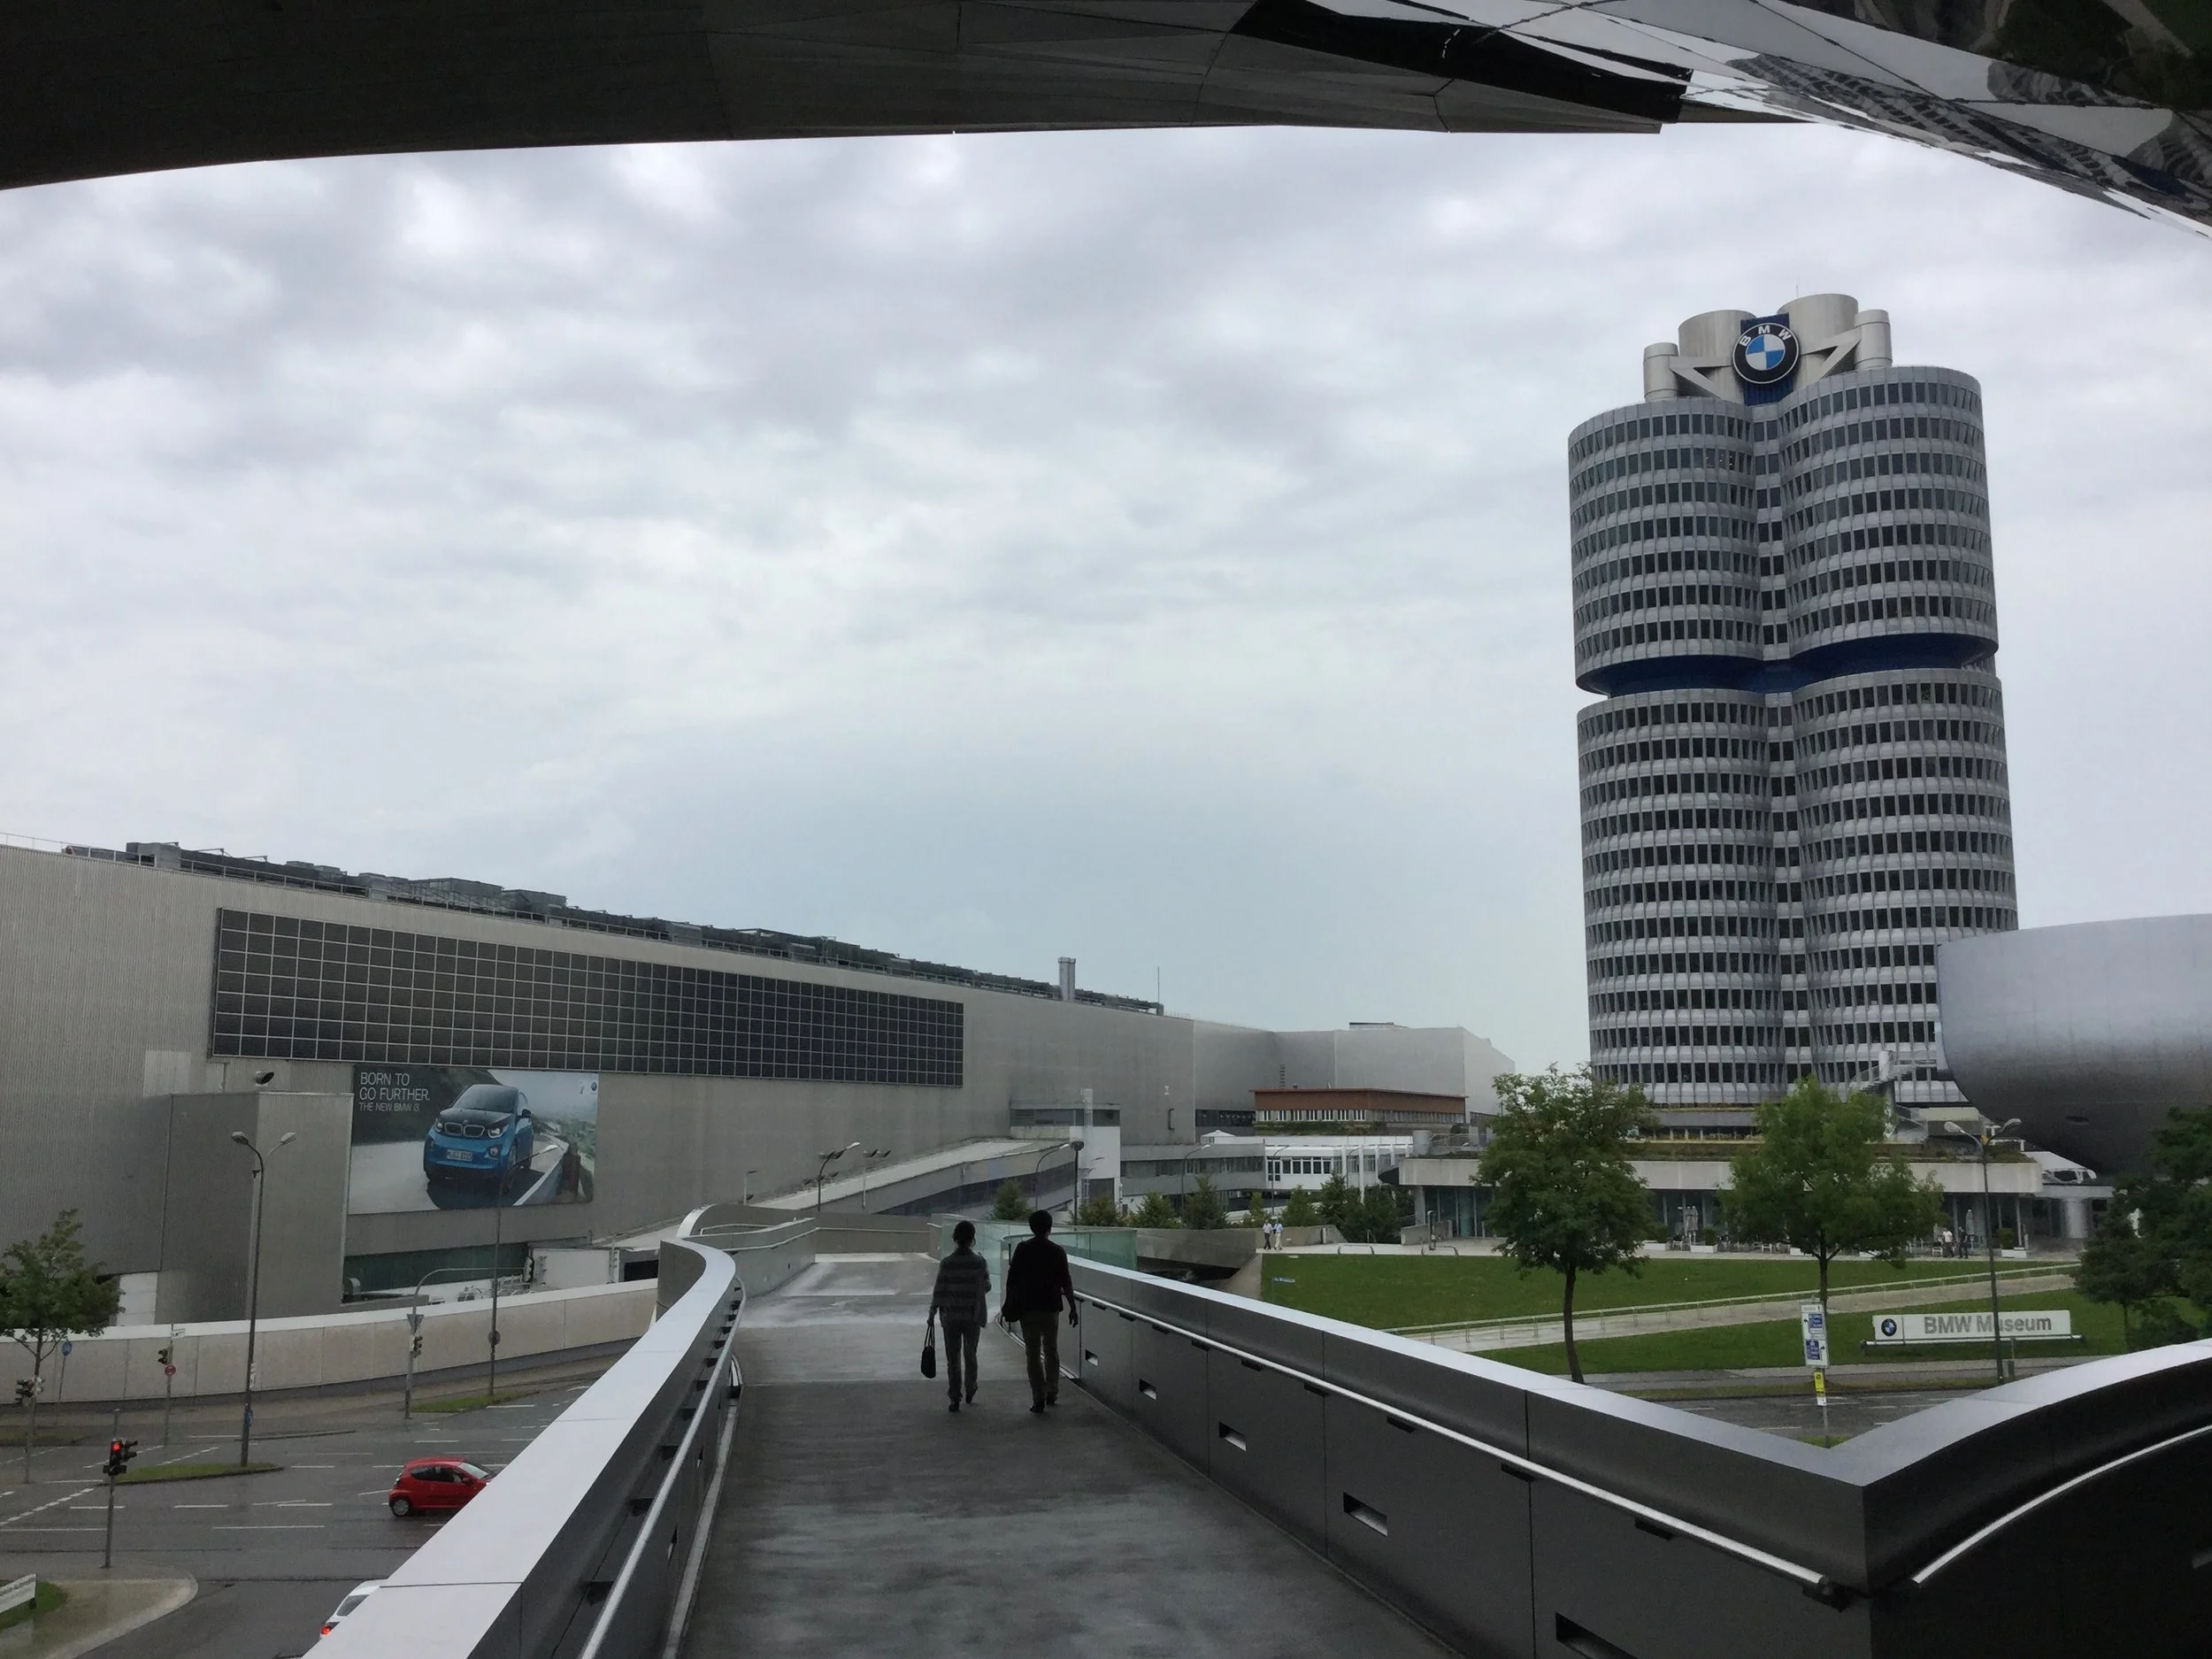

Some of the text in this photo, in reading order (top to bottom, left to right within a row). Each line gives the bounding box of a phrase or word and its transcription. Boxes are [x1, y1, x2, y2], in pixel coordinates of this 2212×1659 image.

[1739, 325, 1792, 347] BMW
[360, 1071, 411, 1087] BORN TO
[359, 1087, 431, 1102] GO FURTHER.
[358, 1102, 374, 1112] THE
[375, 1102, 393, 1112] NEW
[394, 1102, 412, 1112] BMW
[1924, 1315, 1972, 1334] BMW
